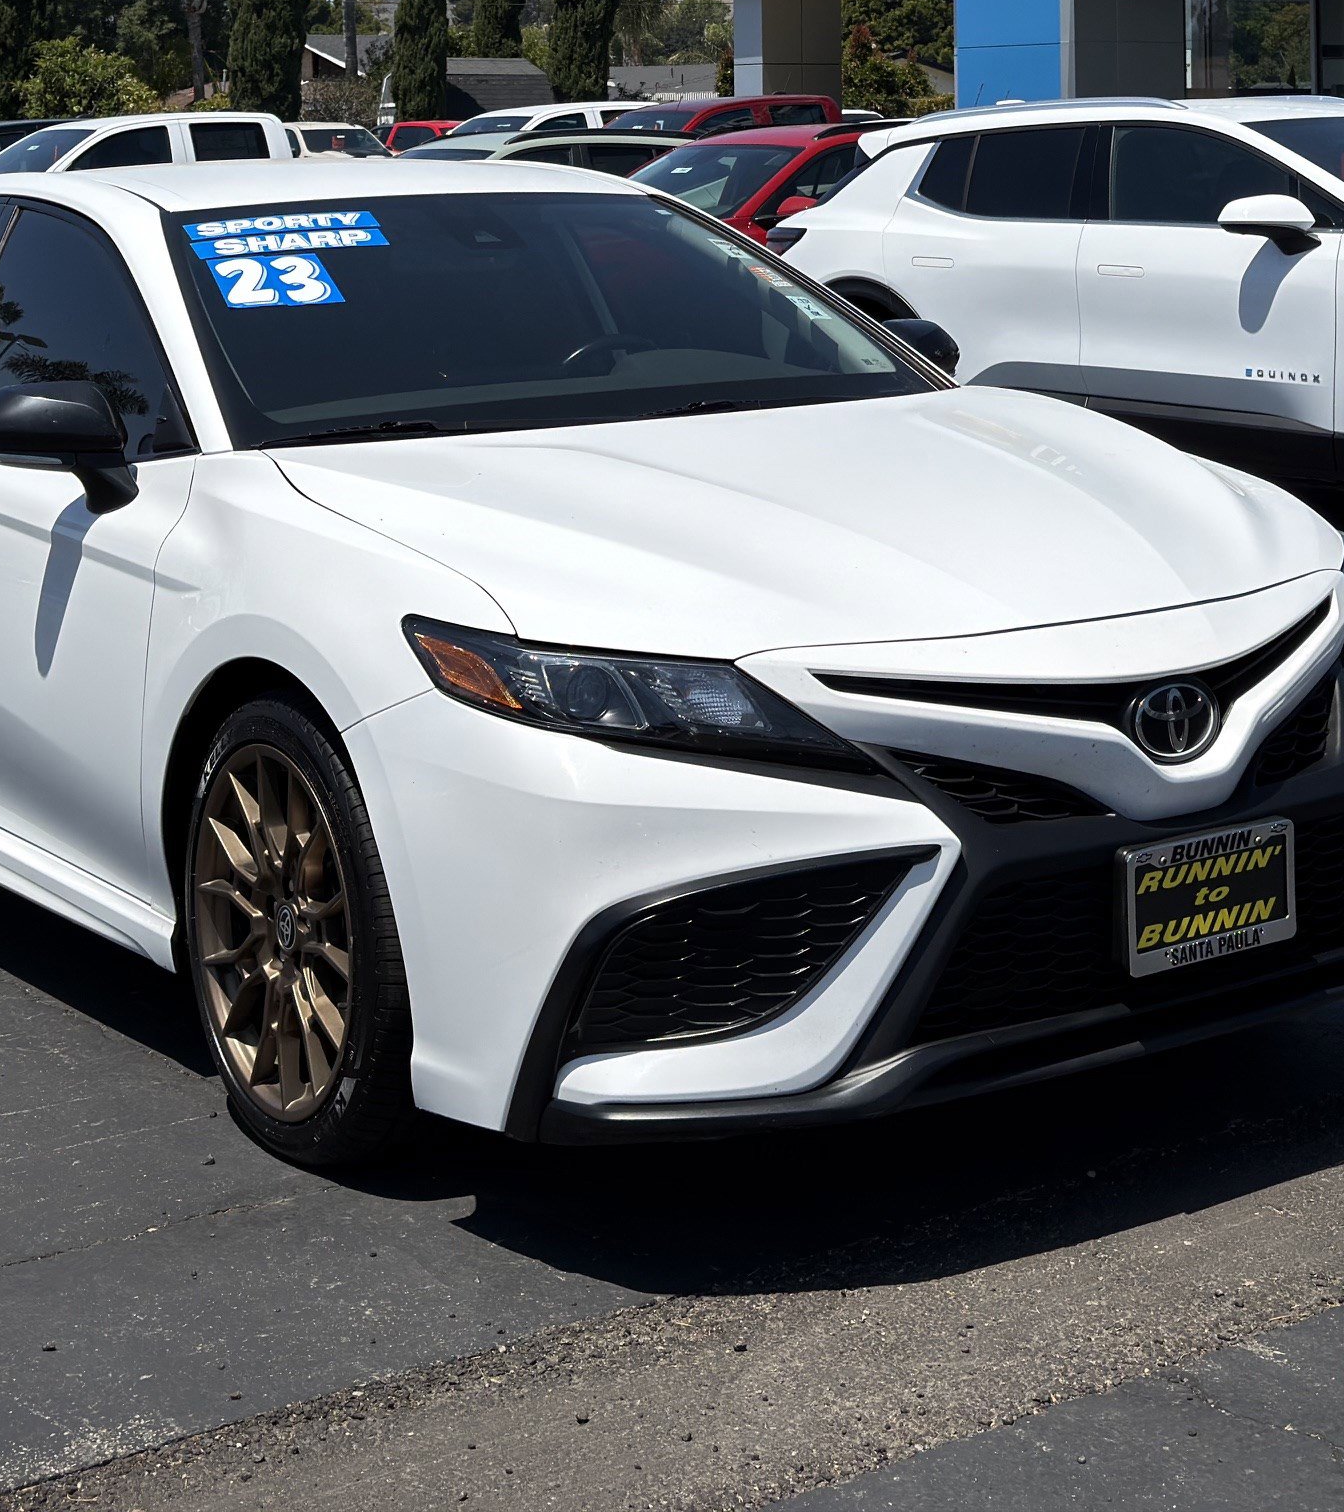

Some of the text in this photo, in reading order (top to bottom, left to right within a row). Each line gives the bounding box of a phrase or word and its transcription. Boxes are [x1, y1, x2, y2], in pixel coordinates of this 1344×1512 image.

[197, 213, 360, 236] SPORTY
[214, 229, 371, 255] SHARP
[215, 256, 331, 304] 23
[1170, 829, 1252, 864] BUNNIN
[1136, 845, 1282, 895] RUNNIN'
[1194, 885, 1230, 906] to
[1136, 897, 1276, 950] BUNNIN
[1168, 930, 1261, 965] SANTA PAULA
